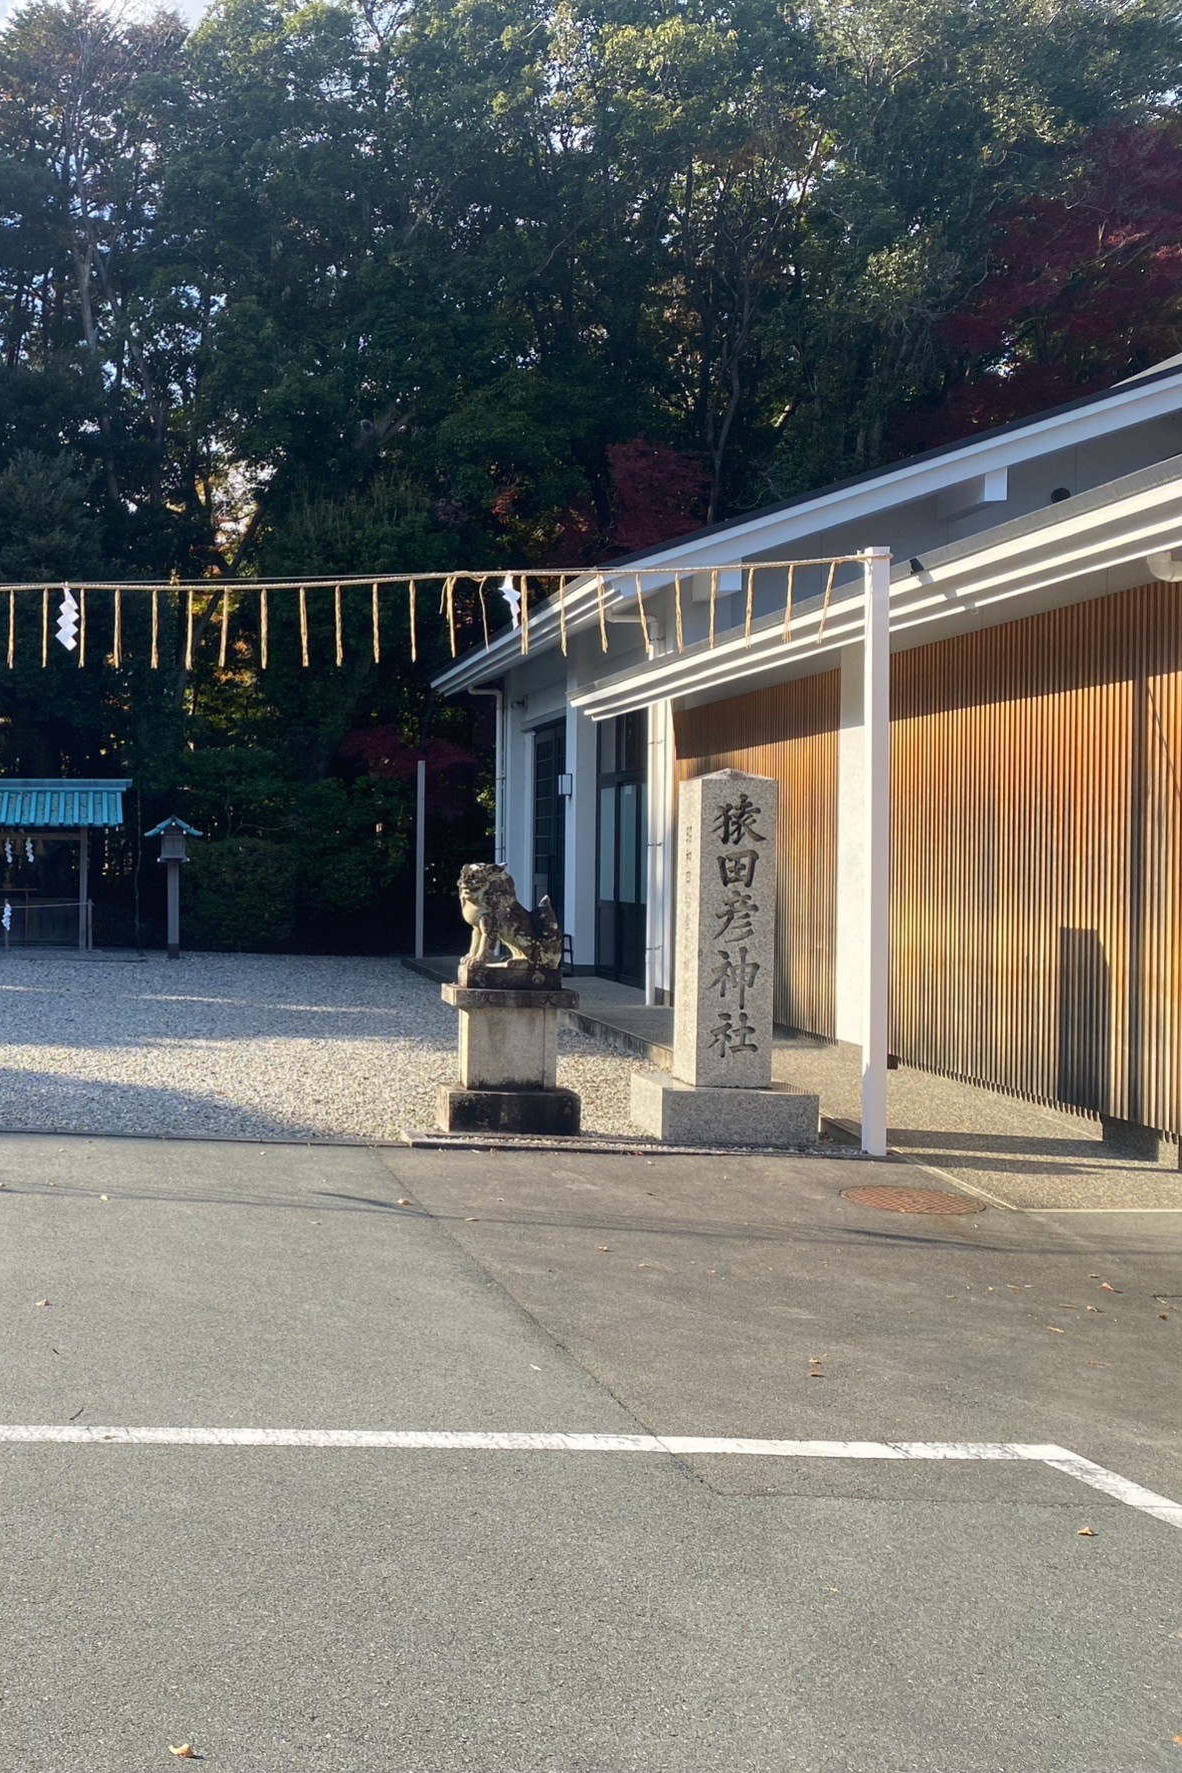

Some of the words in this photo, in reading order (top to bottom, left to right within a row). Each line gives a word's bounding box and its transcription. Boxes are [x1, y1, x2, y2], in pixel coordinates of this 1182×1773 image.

[707, 793, 767, 1059] 猿田彦神社
